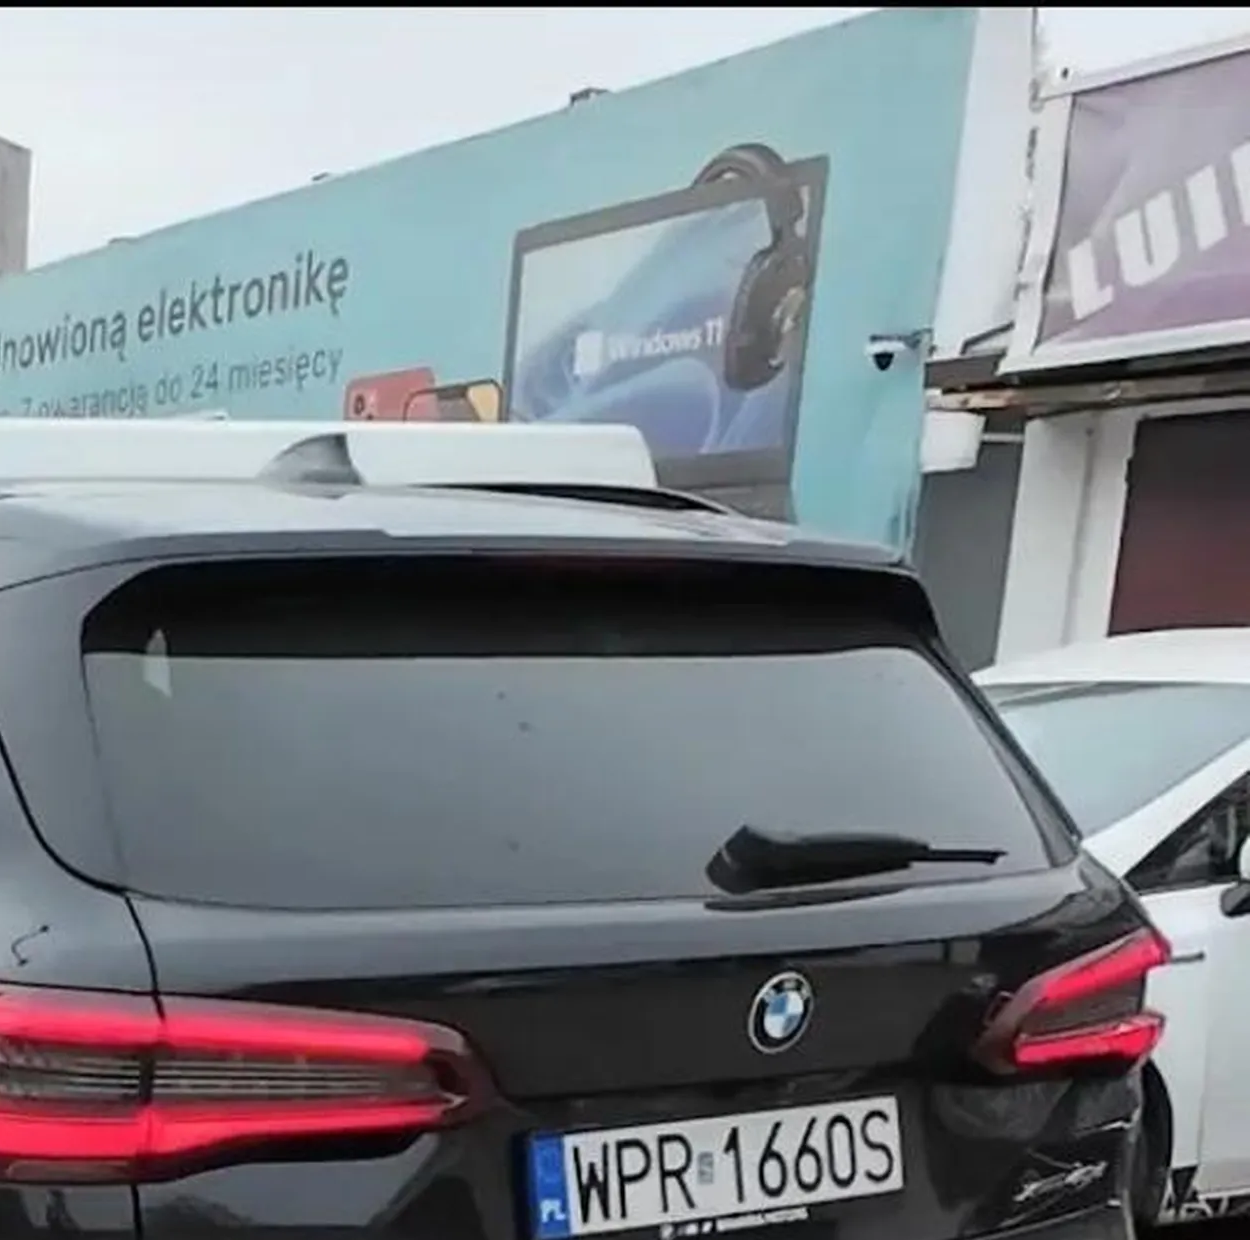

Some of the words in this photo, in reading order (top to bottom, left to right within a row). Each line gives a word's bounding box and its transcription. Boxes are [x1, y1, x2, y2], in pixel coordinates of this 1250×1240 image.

[137, 249, 348, 342] elektronikę
[155, 370, 182, 406] do
[190, 362, 219, 400] 24
[228, 347, 344, 393] miesięcy
[573, 1133, 695, 1224] WPR
[723, 1109, 895, 1204] 1660S
